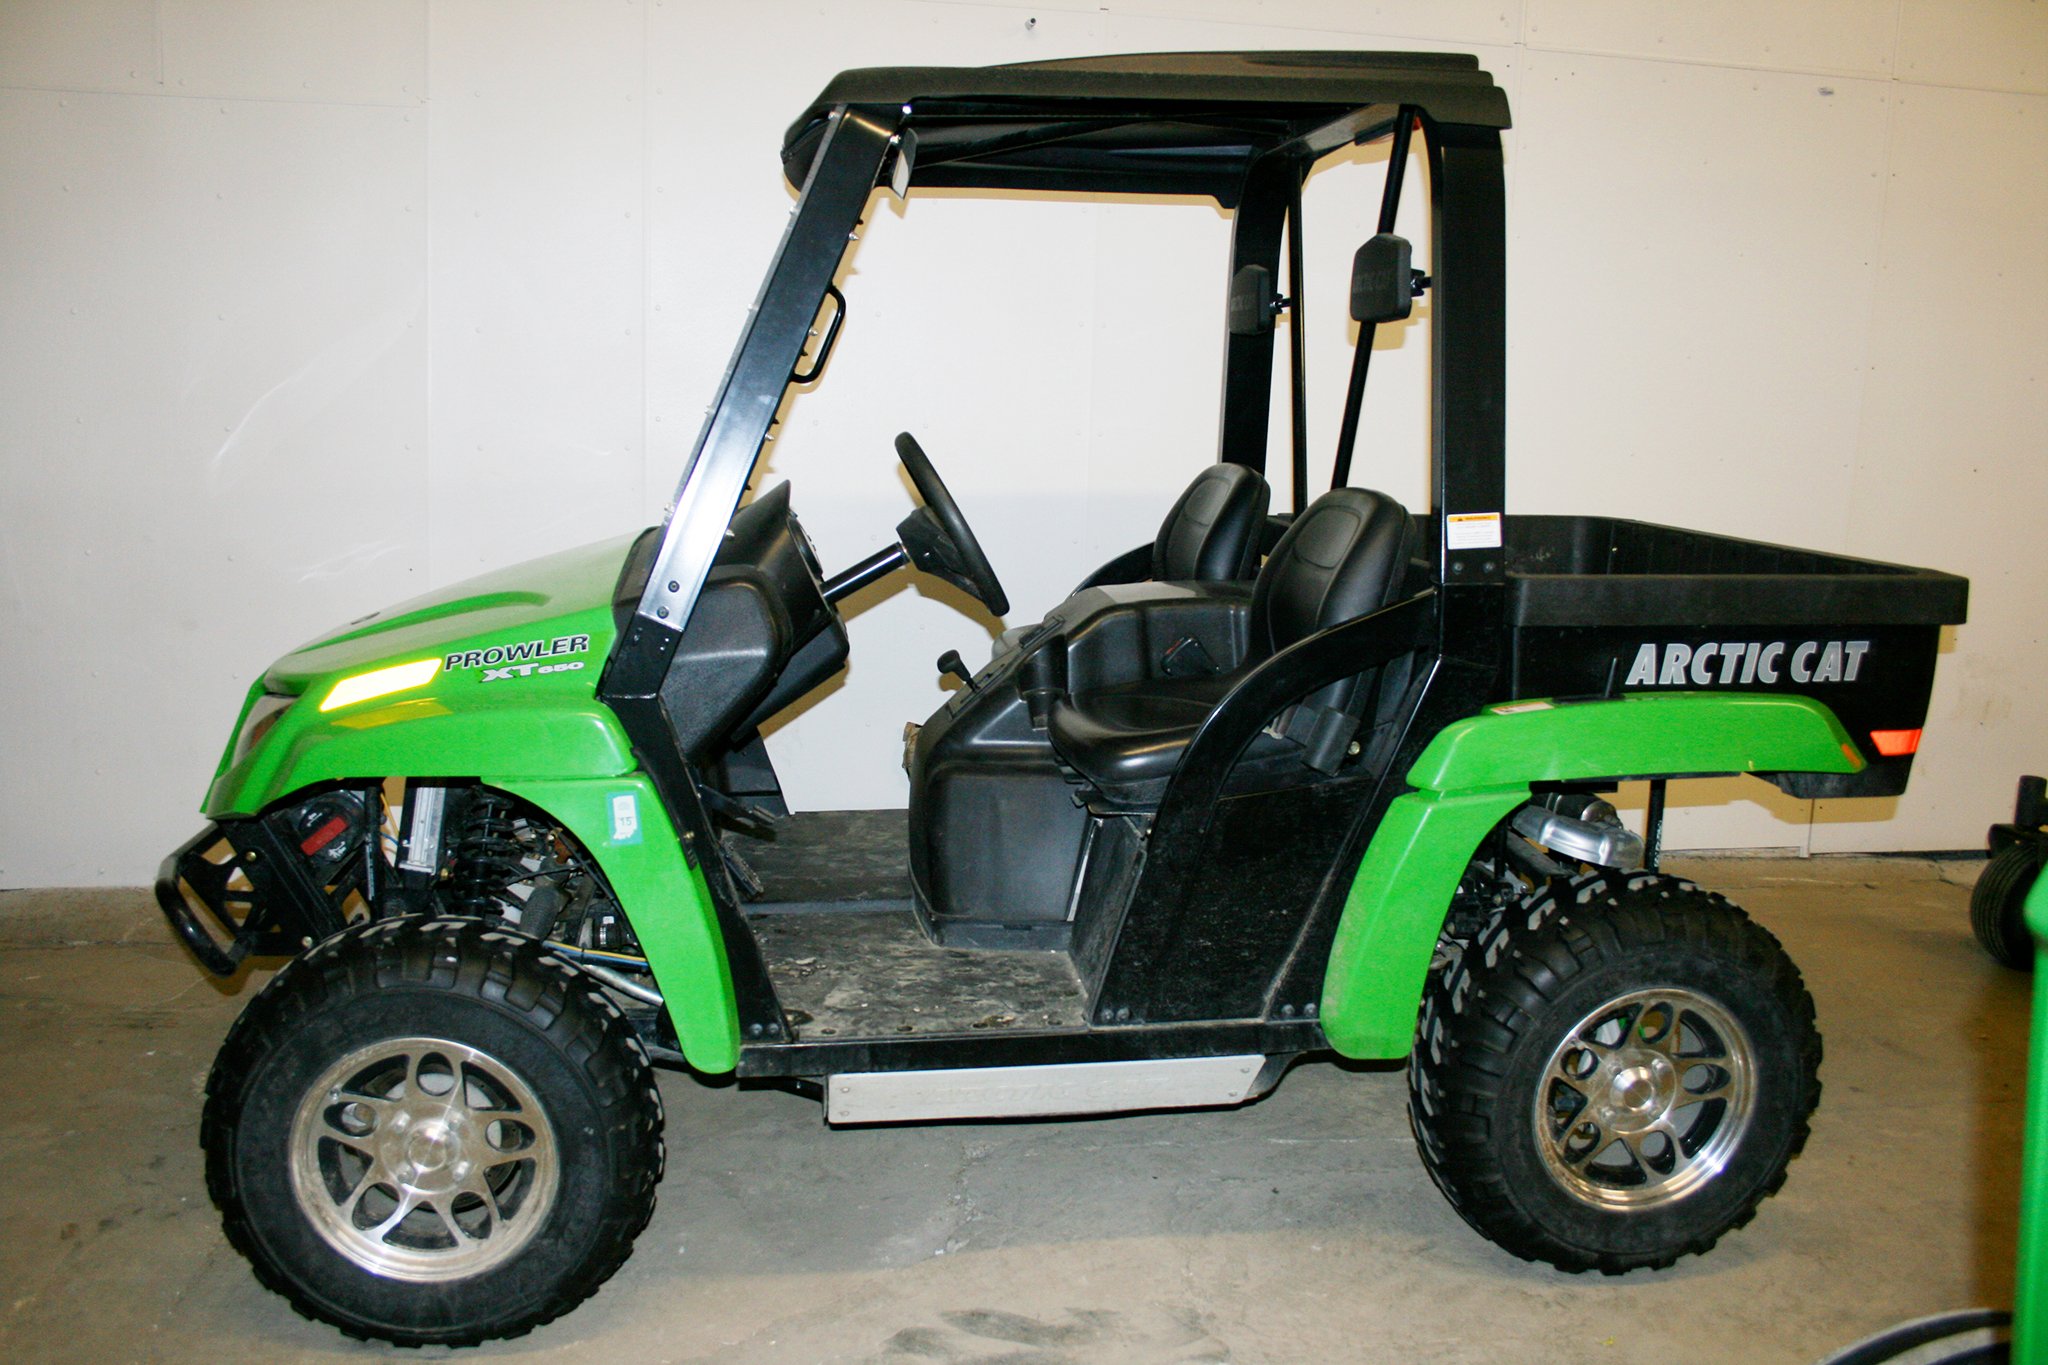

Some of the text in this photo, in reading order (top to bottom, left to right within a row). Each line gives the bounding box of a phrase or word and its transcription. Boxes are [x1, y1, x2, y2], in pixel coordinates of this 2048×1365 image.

[444, 634, 589, 671] PROWLER
[1625, 641, 1870, 685] ARCTIC CAT
